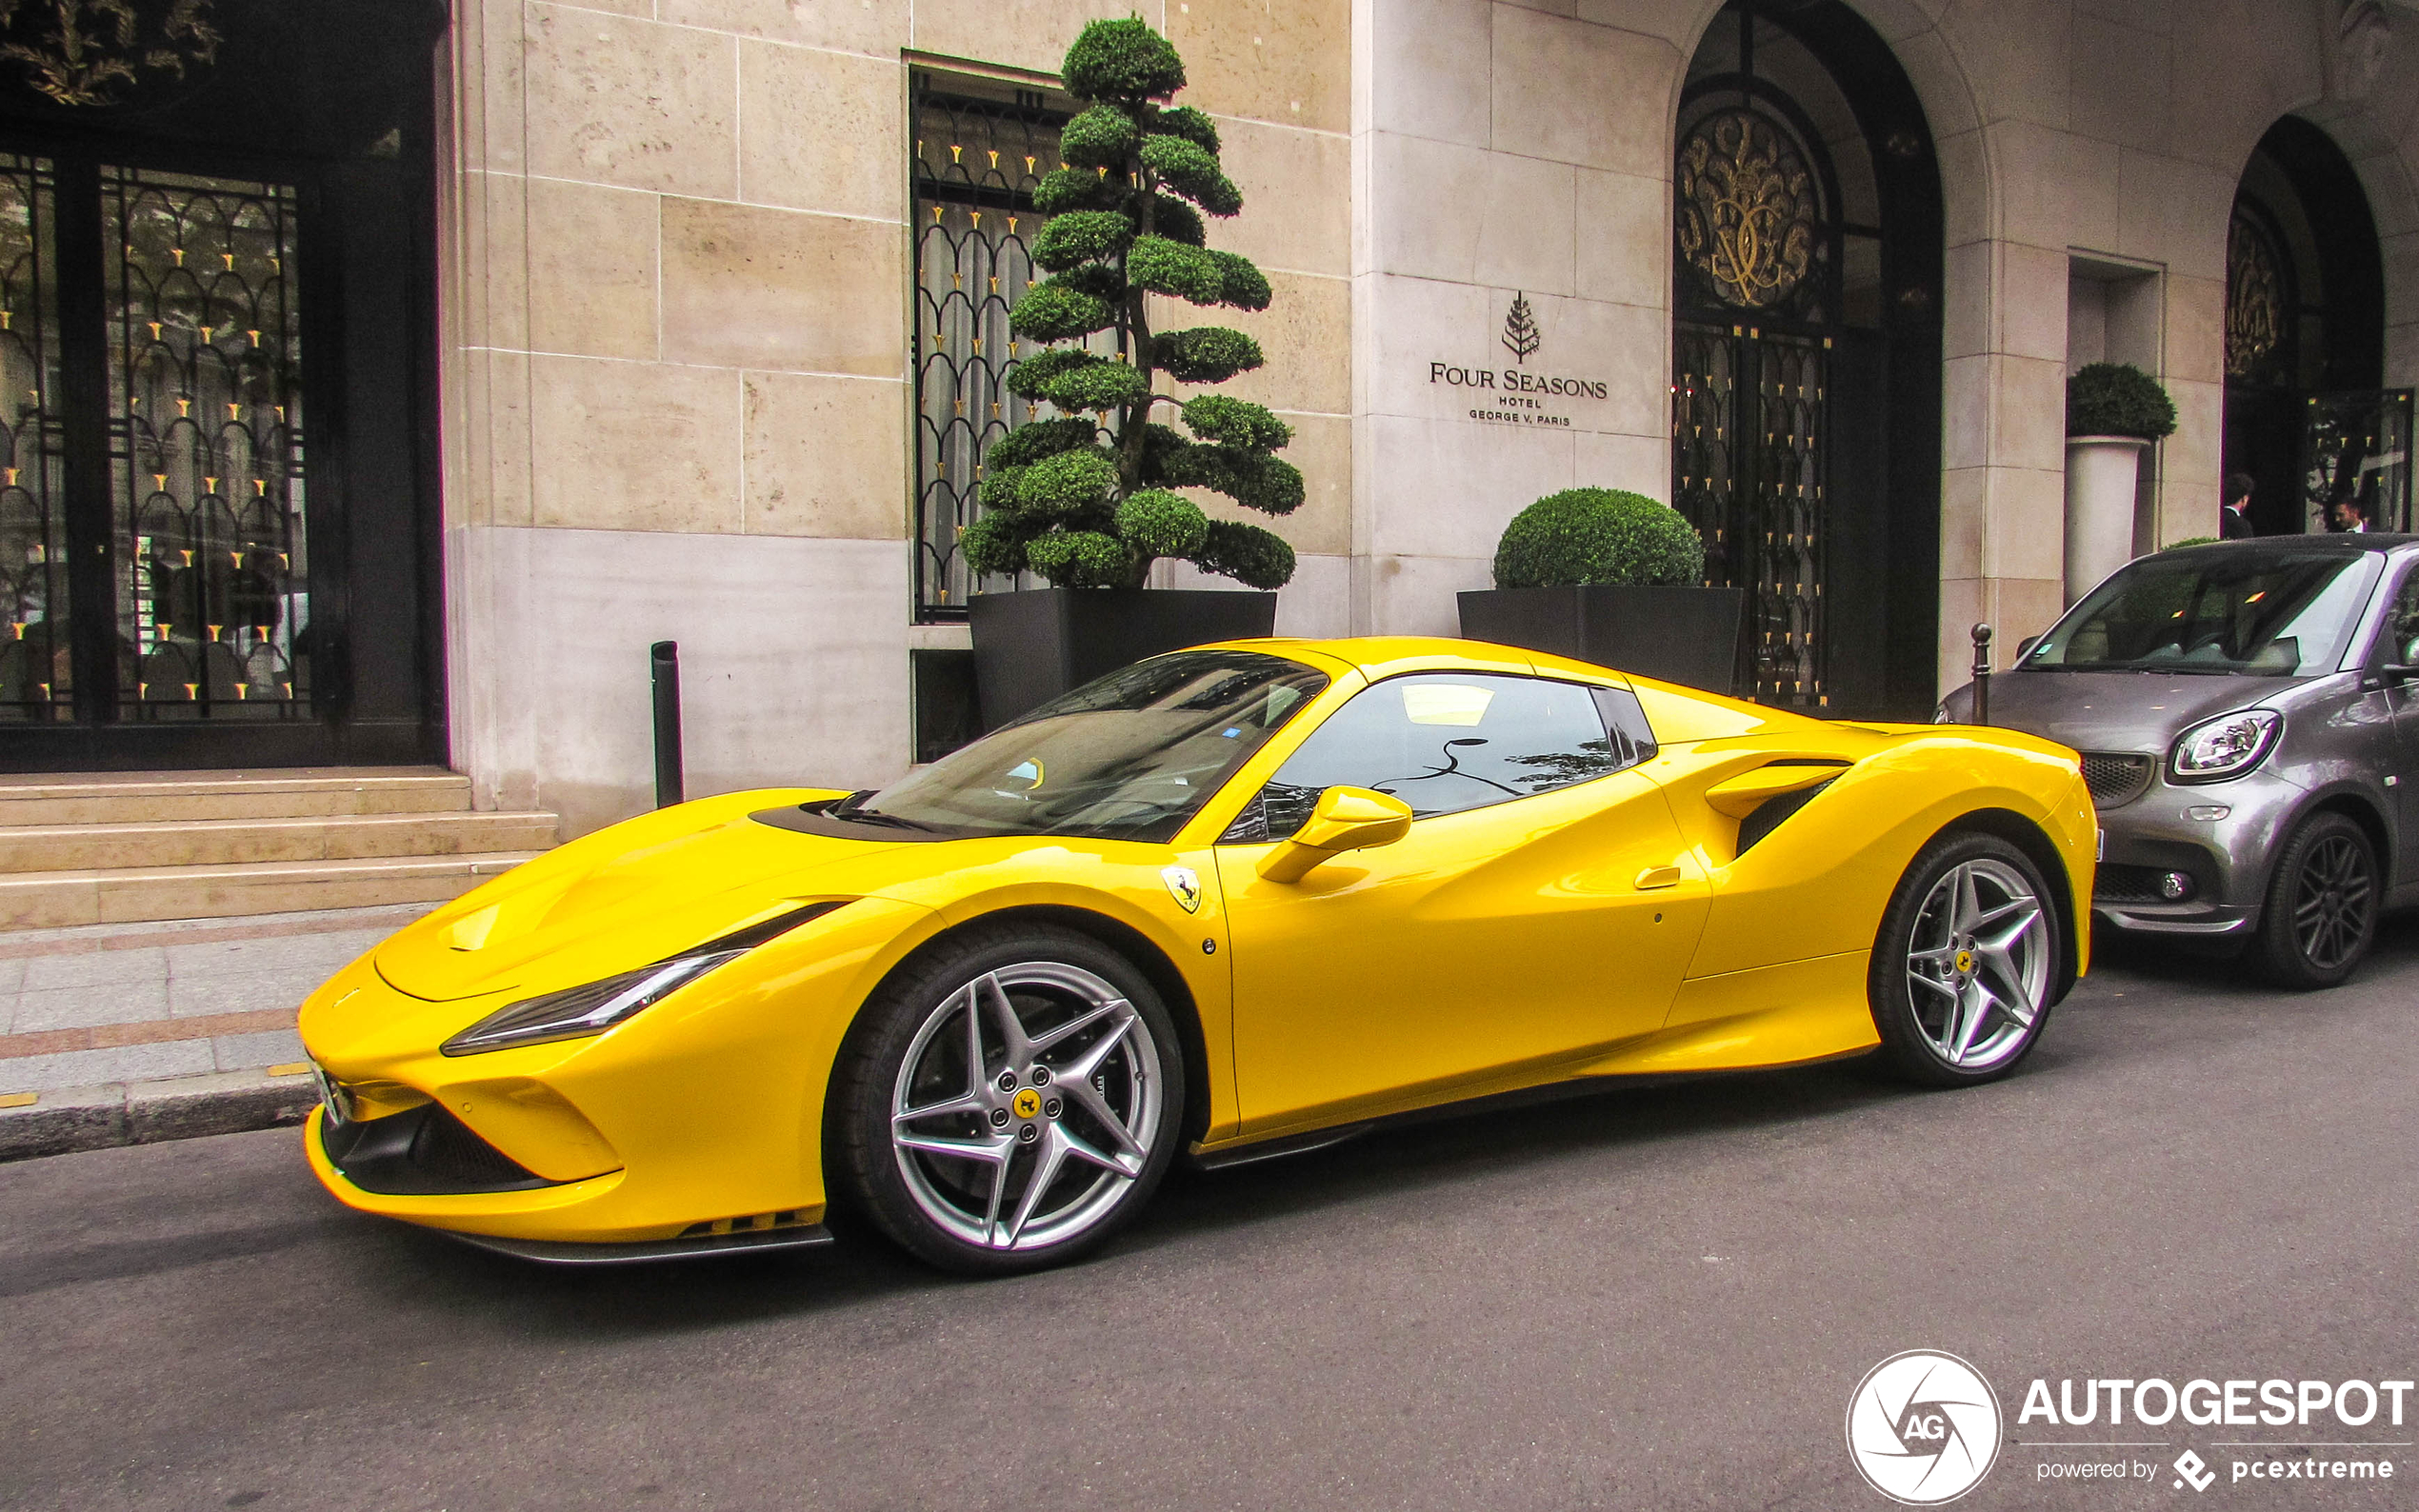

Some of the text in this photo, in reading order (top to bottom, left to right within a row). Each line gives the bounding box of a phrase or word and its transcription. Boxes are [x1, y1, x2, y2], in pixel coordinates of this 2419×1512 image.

[1429, 362, 1608, 400] FOUR SEASONS
[1499, 396, 1542, 408] HOTEL
[1469, 409, 1519, 423] GEORGE
[1537, 415, 1570, 427] PARIS
